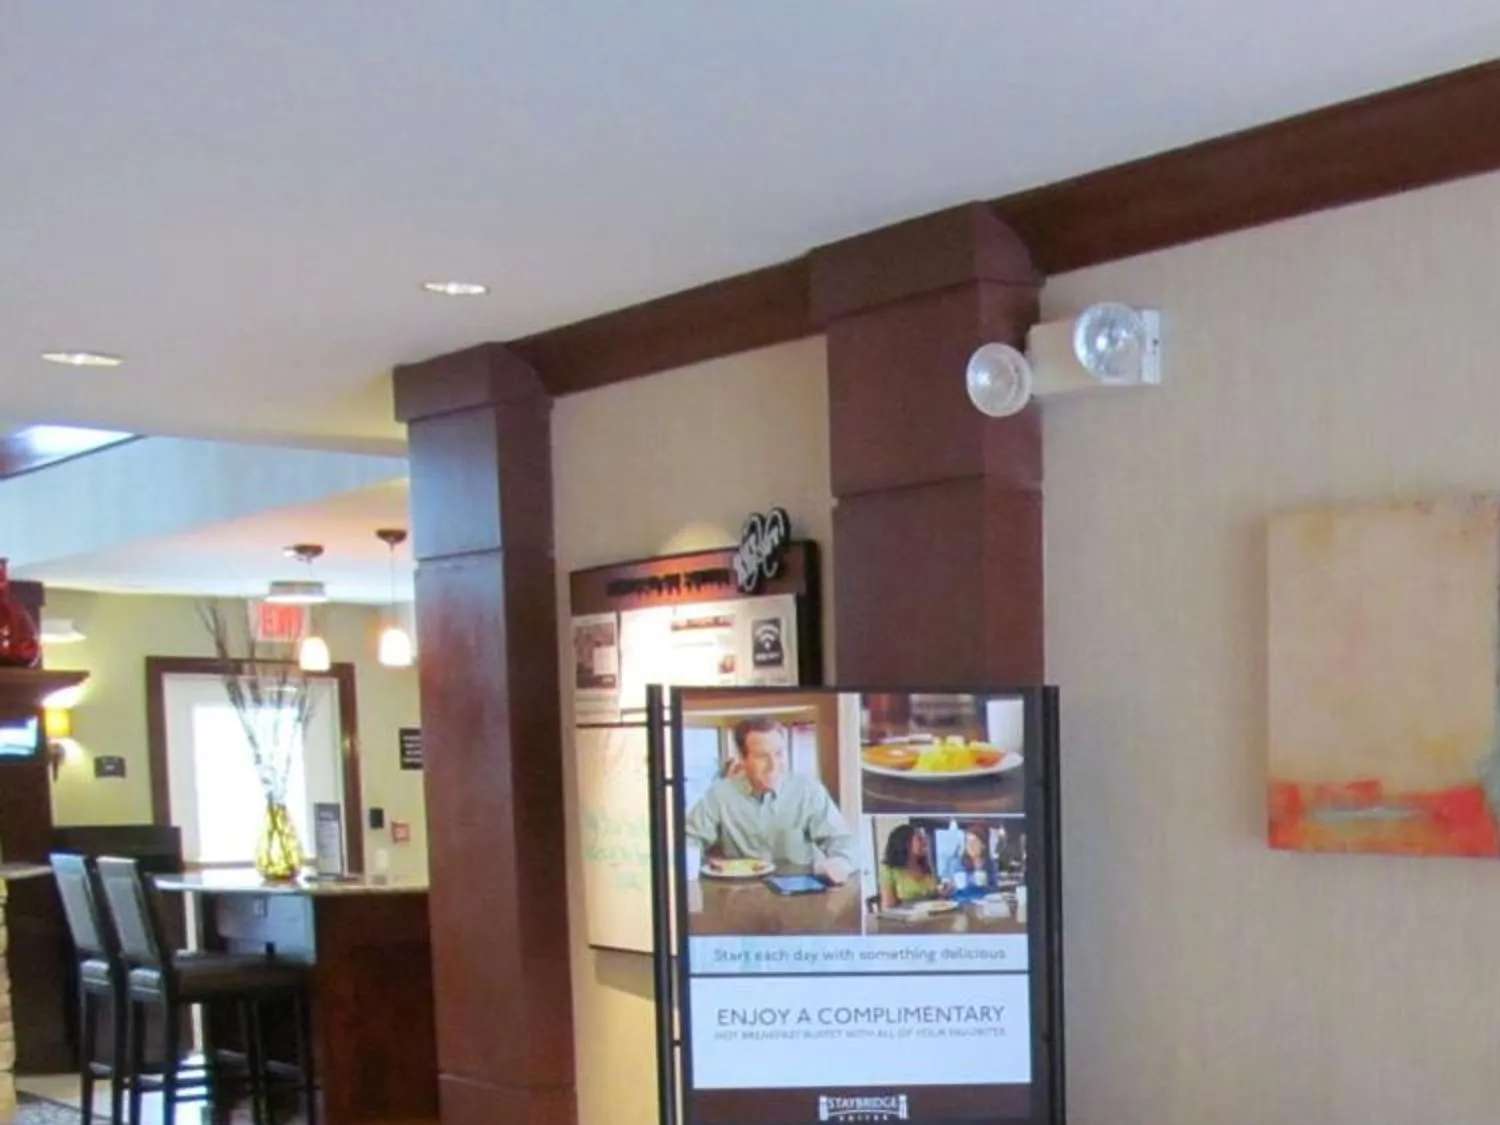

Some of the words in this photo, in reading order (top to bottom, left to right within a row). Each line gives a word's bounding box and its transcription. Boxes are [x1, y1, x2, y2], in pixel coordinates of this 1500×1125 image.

[714, 948, 749, 962] Start
[755, 949, 788, 961] each
[793, 947, 817, 965] day
[822, 947, 854, 961] with
[859, 946, 936, 964] something
[941, 945, 1006, 960] delicious
[717, 1008, 789, 1026] ENJOY
[797, 1008, 811, 1024] A
[818, 1005, 1005, 1024] COMPLIMENTARY
[827, 1096, 899, 1109] STAYBRIDGE
